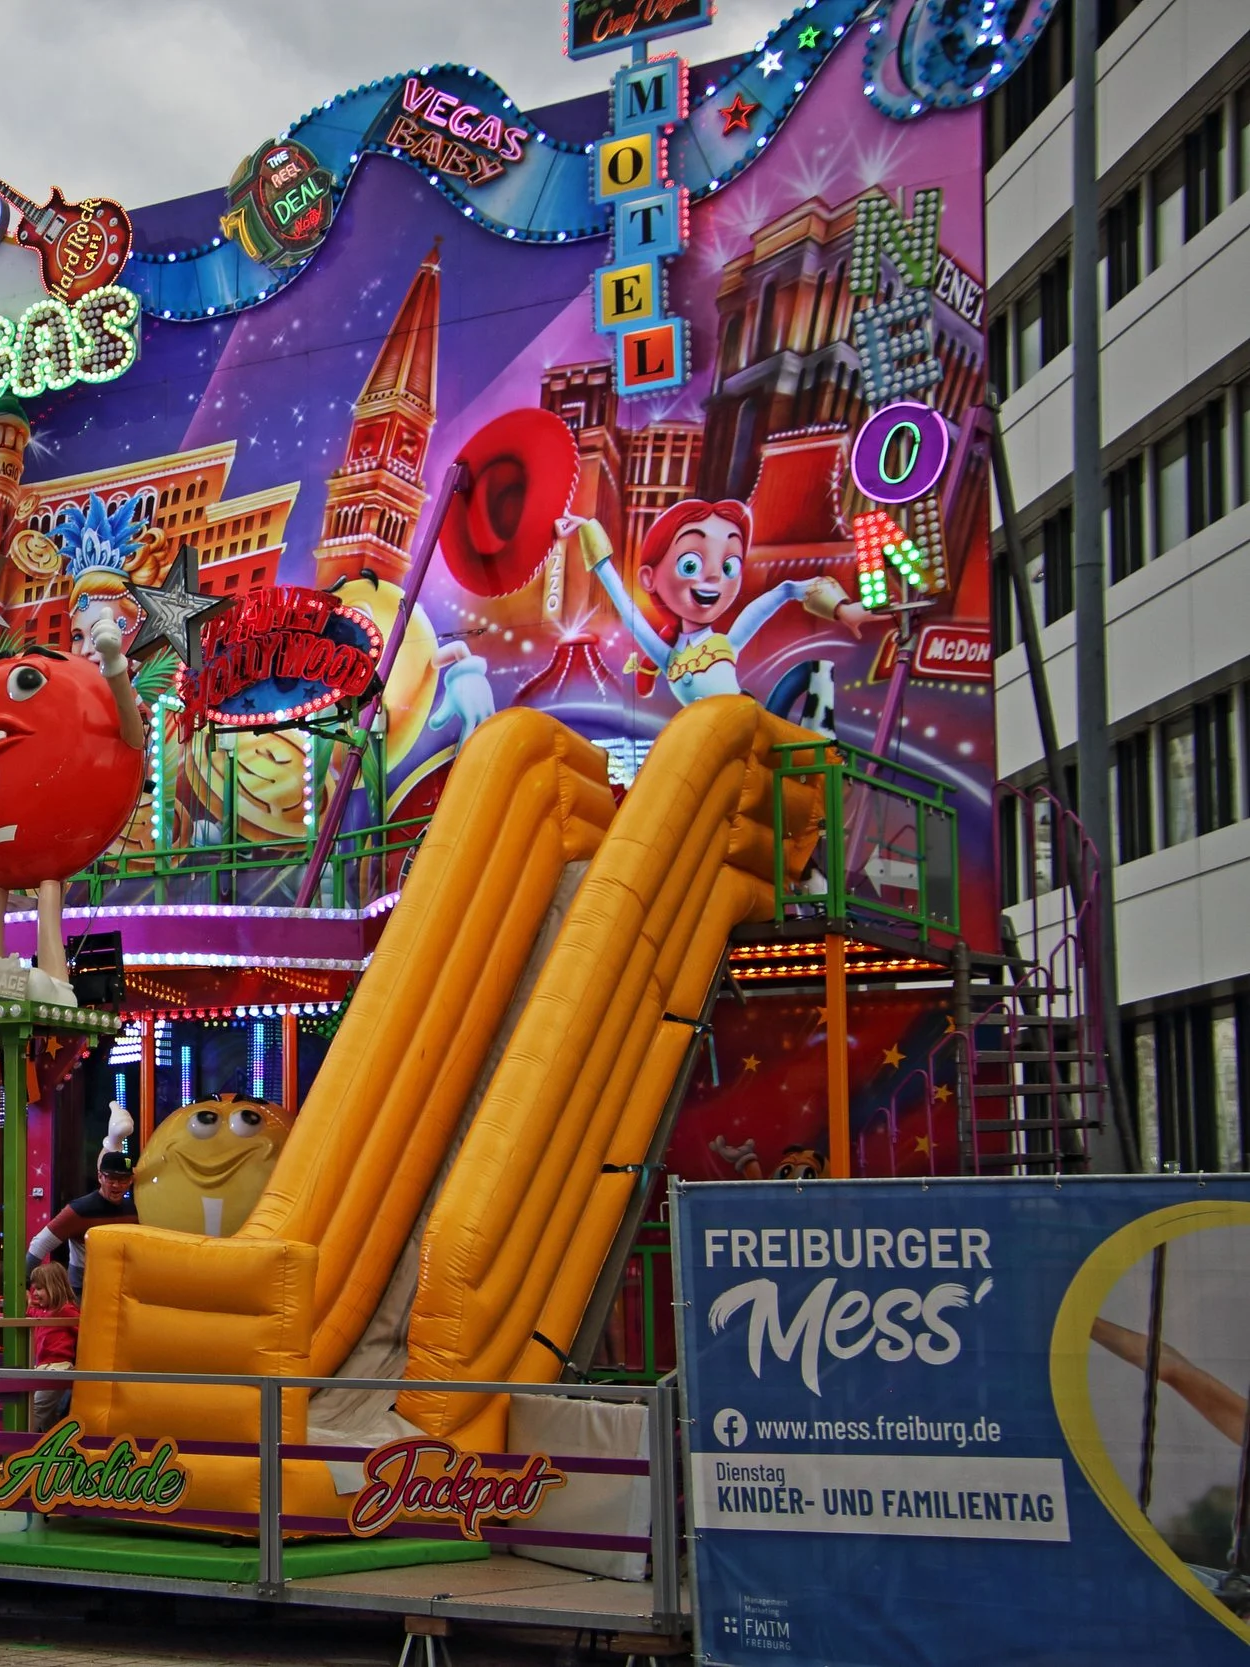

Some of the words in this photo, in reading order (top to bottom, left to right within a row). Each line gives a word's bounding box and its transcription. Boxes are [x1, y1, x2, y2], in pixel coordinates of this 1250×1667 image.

[401, 78, 528, 163] VEGAS
[266, 150, 289, 168] THE
[386, 115, 510, 188] BABY
[271, 161, 301, 188] REEL
[274, 177, 324, 224] DEAL
[608, 73, 667, 378] MOTEL
[83, 234, 103, 270] CAFE
[204, 585, 335, 662] PLANET
[177, 630, 375, 744] HOLLYWOOD
[705, 1228, 992, 1269] FREIBURGER
[756, 1415, 1002, 1448] www.mess.freiburg.de
[352, 1440, 564, 1538] Jackpot
[715, 1462, 785, 1486] Dienstag
[717, 1486, 815, 1516] KINDER-
[823, 1488, 874, 1517] UND
[882, 1490, 1055, 1523] FAMILIENTAG
[745, 1618, 790, 1639] FWTM
[745, 1638, 792, 1651] FREIBURG
